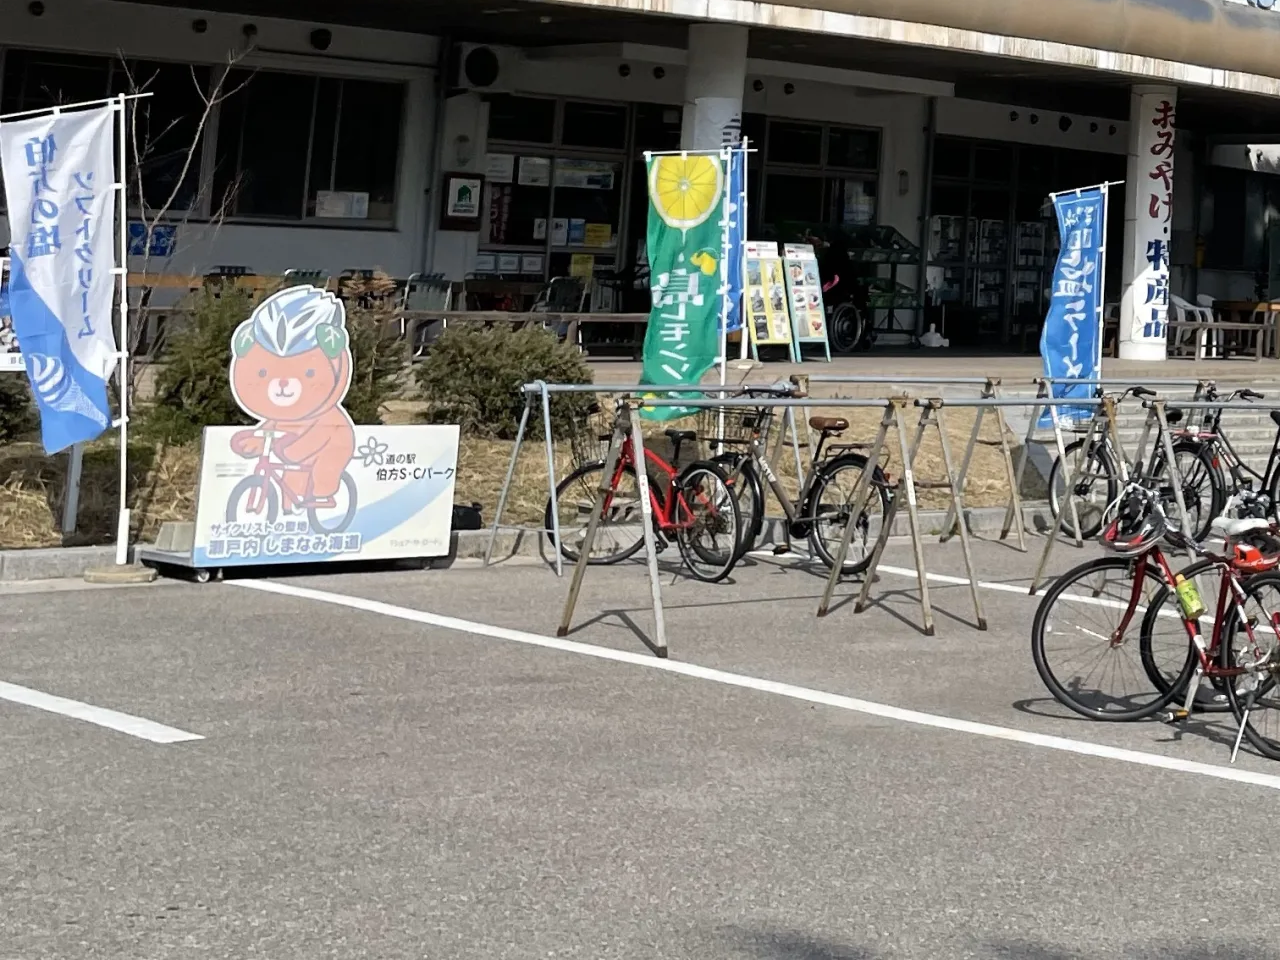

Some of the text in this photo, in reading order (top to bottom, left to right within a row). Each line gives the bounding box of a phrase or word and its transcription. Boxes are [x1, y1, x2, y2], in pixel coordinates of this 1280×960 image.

[386, 453, 416, 464] 道の駅
[209, 535, 360, 555] 瀬戸内 しまなみ海道
